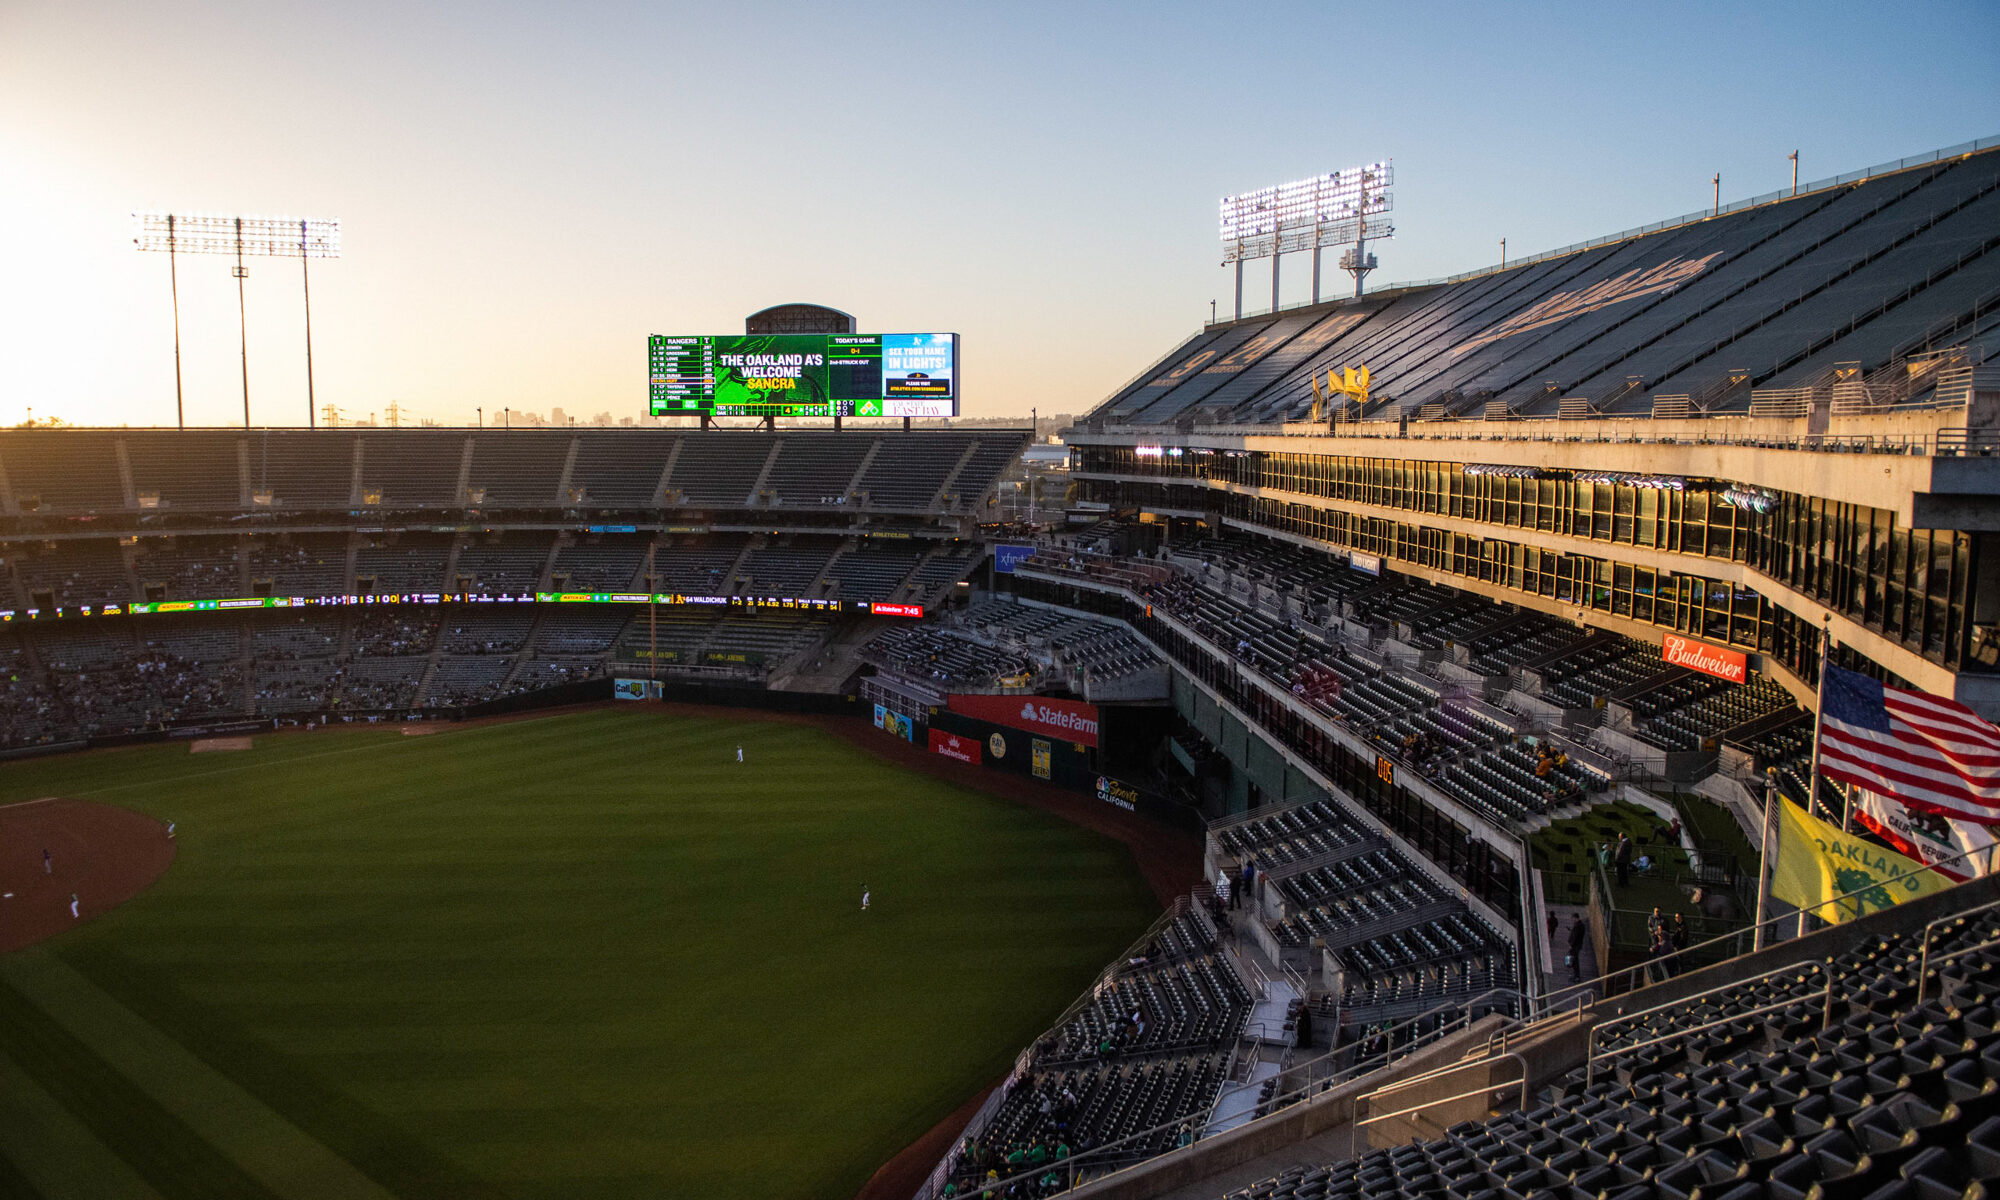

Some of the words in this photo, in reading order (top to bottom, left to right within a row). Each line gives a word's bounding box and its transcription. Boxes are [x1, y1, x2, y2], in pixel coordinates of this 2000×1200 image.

[889, 348, 902, 356] SEE
[904, 348, 923, 356] YOUR
[926, 347, 946, 356] NAME
[720, 355, 744, 366] THE
[746, 355, 802, 366] OAKLAND
[805, 354, 823, 366] A'S
[888, 357, 900, 369] IN
[903, 357, 946, 369] LIGHTS!
[741, 367, 802, 378] WELCOME
[747, 378, 796, 389] SANCRA
[893, 406, 920, 416] EAST
[922, 406, 940, 416] BAY
[1001, 553, 1027, 566] xfinit
[350, 596, 358, 604] B
[366, 595, 374, 604] S
[402, 595, 409, 603] 4
[453, 594, 461, 602] 4
[694, 596, 727, 604] WALDICHUK
[904, 607, 919, 615] 7:45
[1666, 636, 1741, 678] Budweiser
[616, 683, 630, 692] Call
[938, 744, 971, 762] Budweiser
[1033, 766, 1049, 778] FIELD
[1110, 780, 1138, 804] Sports
[1098, 791, 1135, 811] CALIFORNIA
